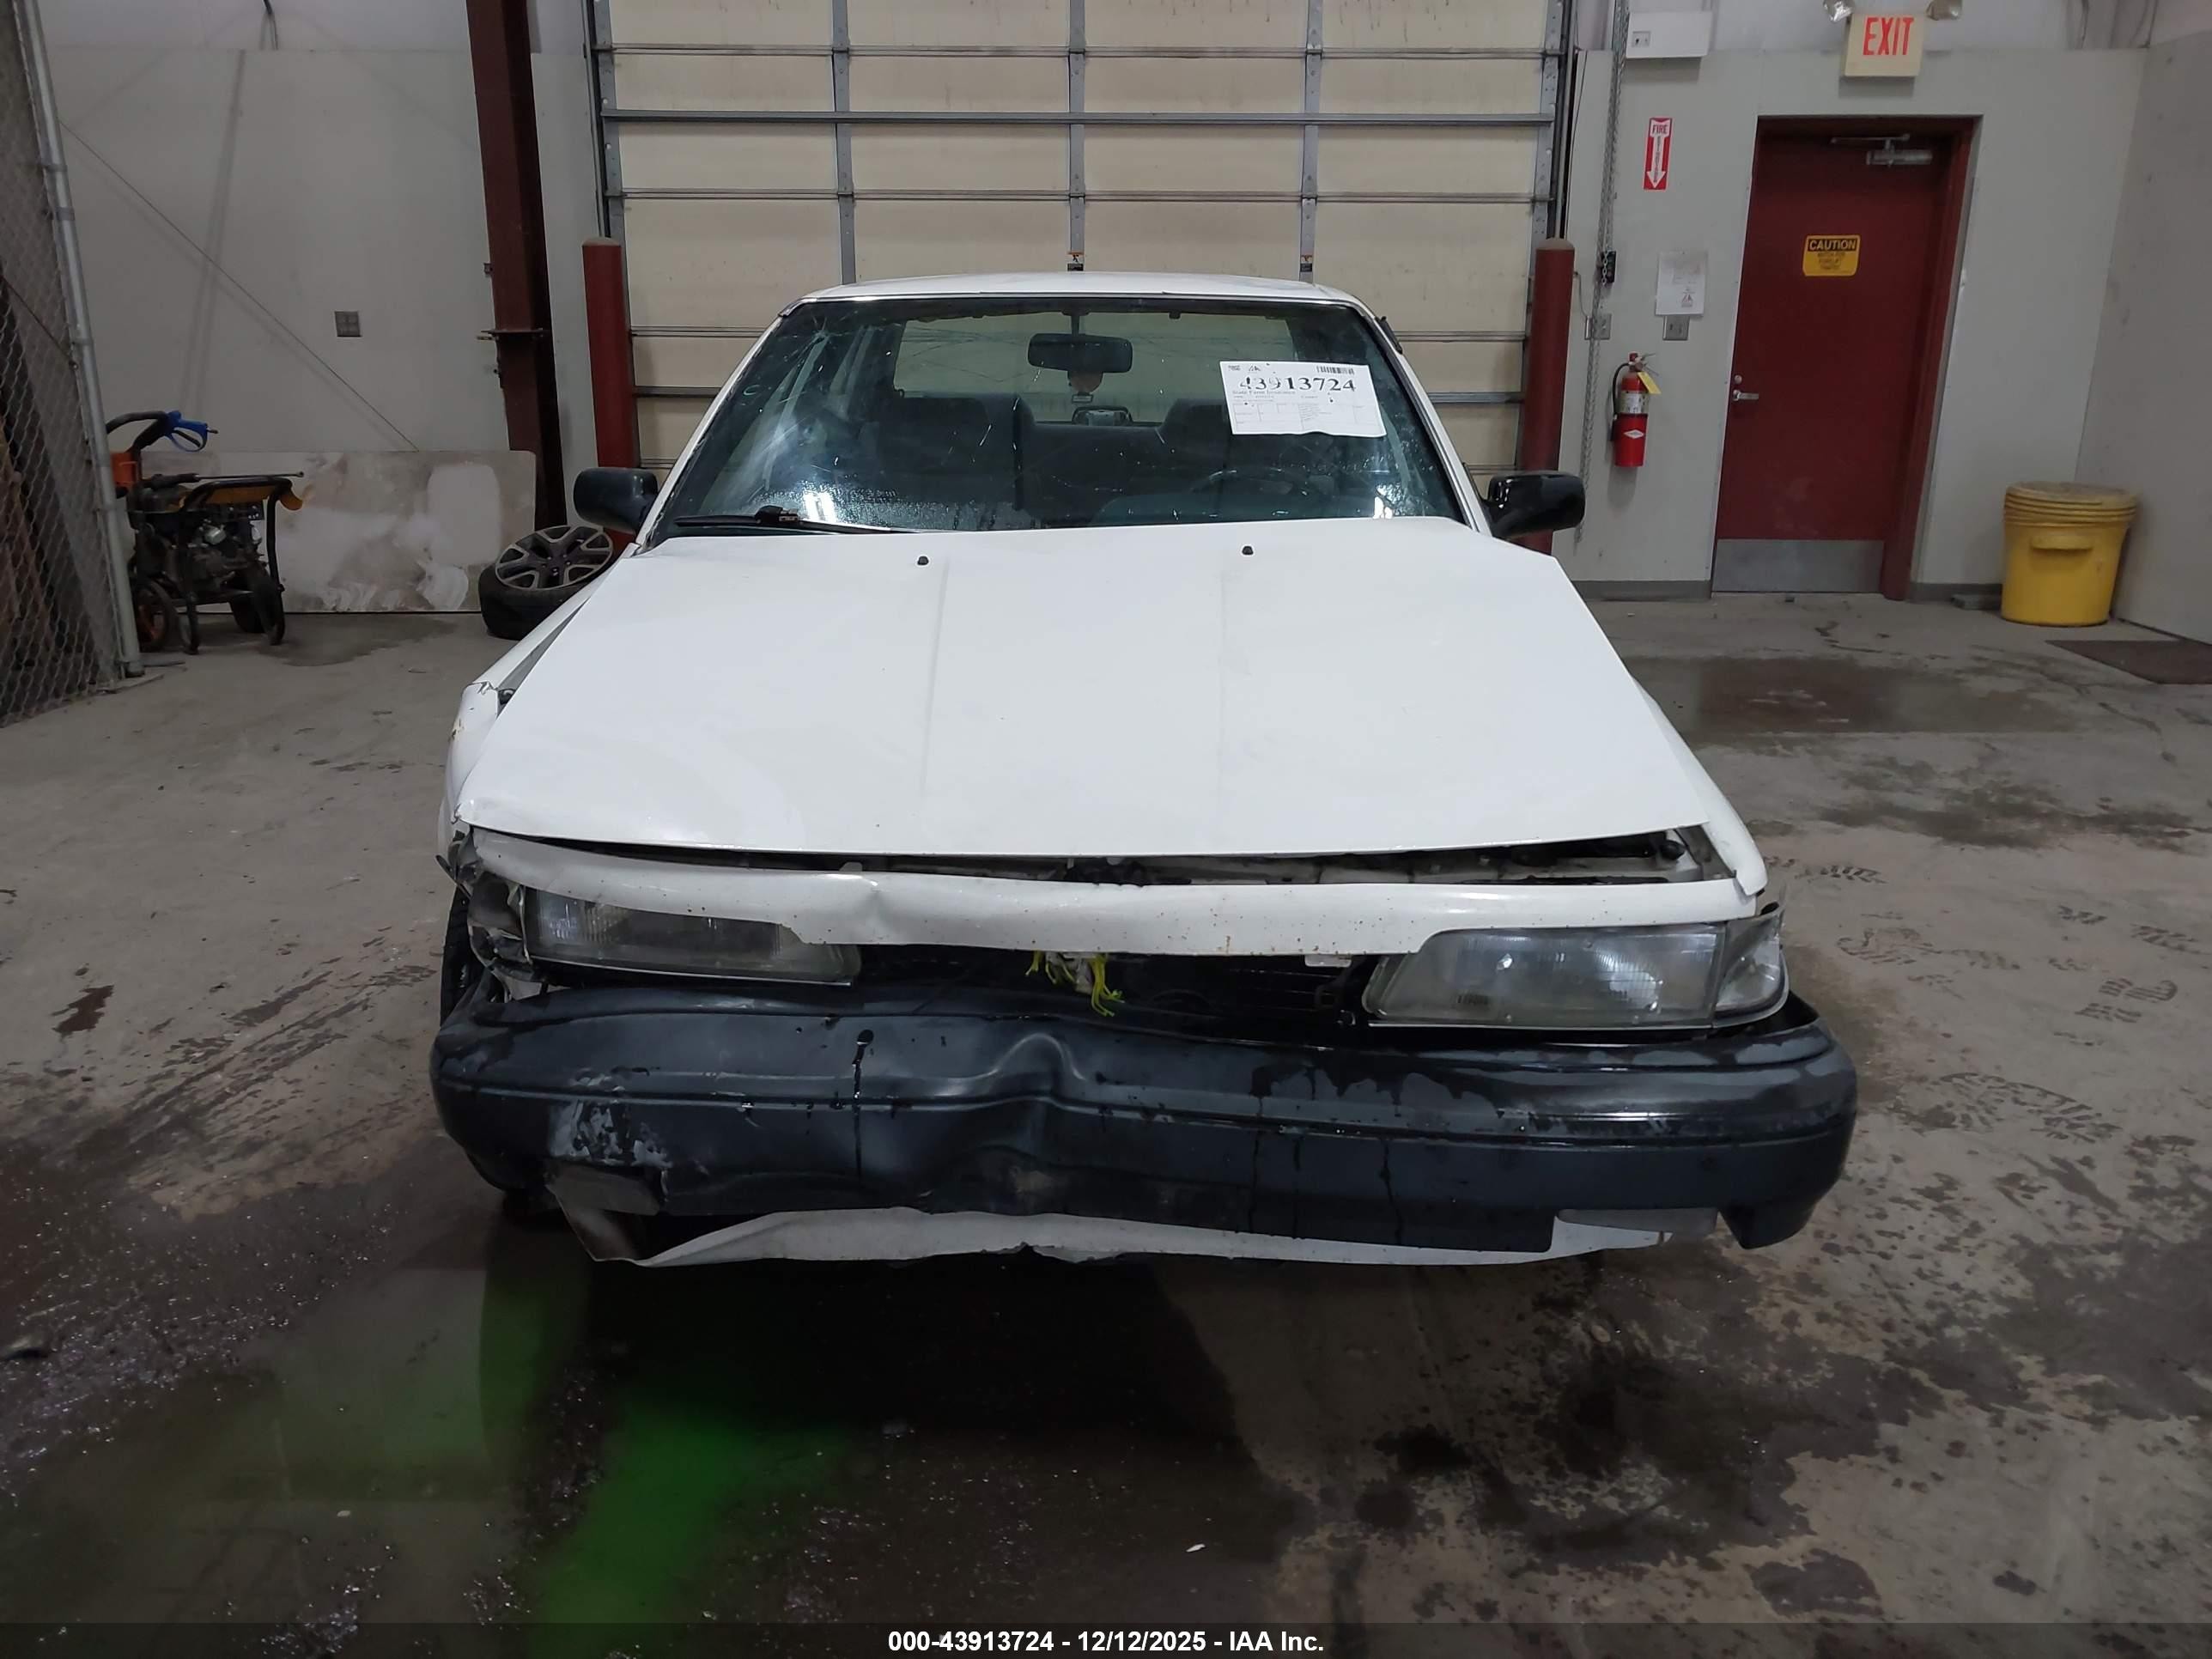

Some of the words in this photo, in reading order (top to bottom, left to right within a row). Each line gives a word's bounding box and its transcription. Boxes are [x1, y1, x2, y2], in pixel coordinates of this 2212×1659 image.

[1862, 16, 1915, 57] EXIT
[1652, 124, 1668, 135] FIRE
[1809, 240, 1856, 250] CAUTION
[1239, 376, 1356, 392] 43913724
